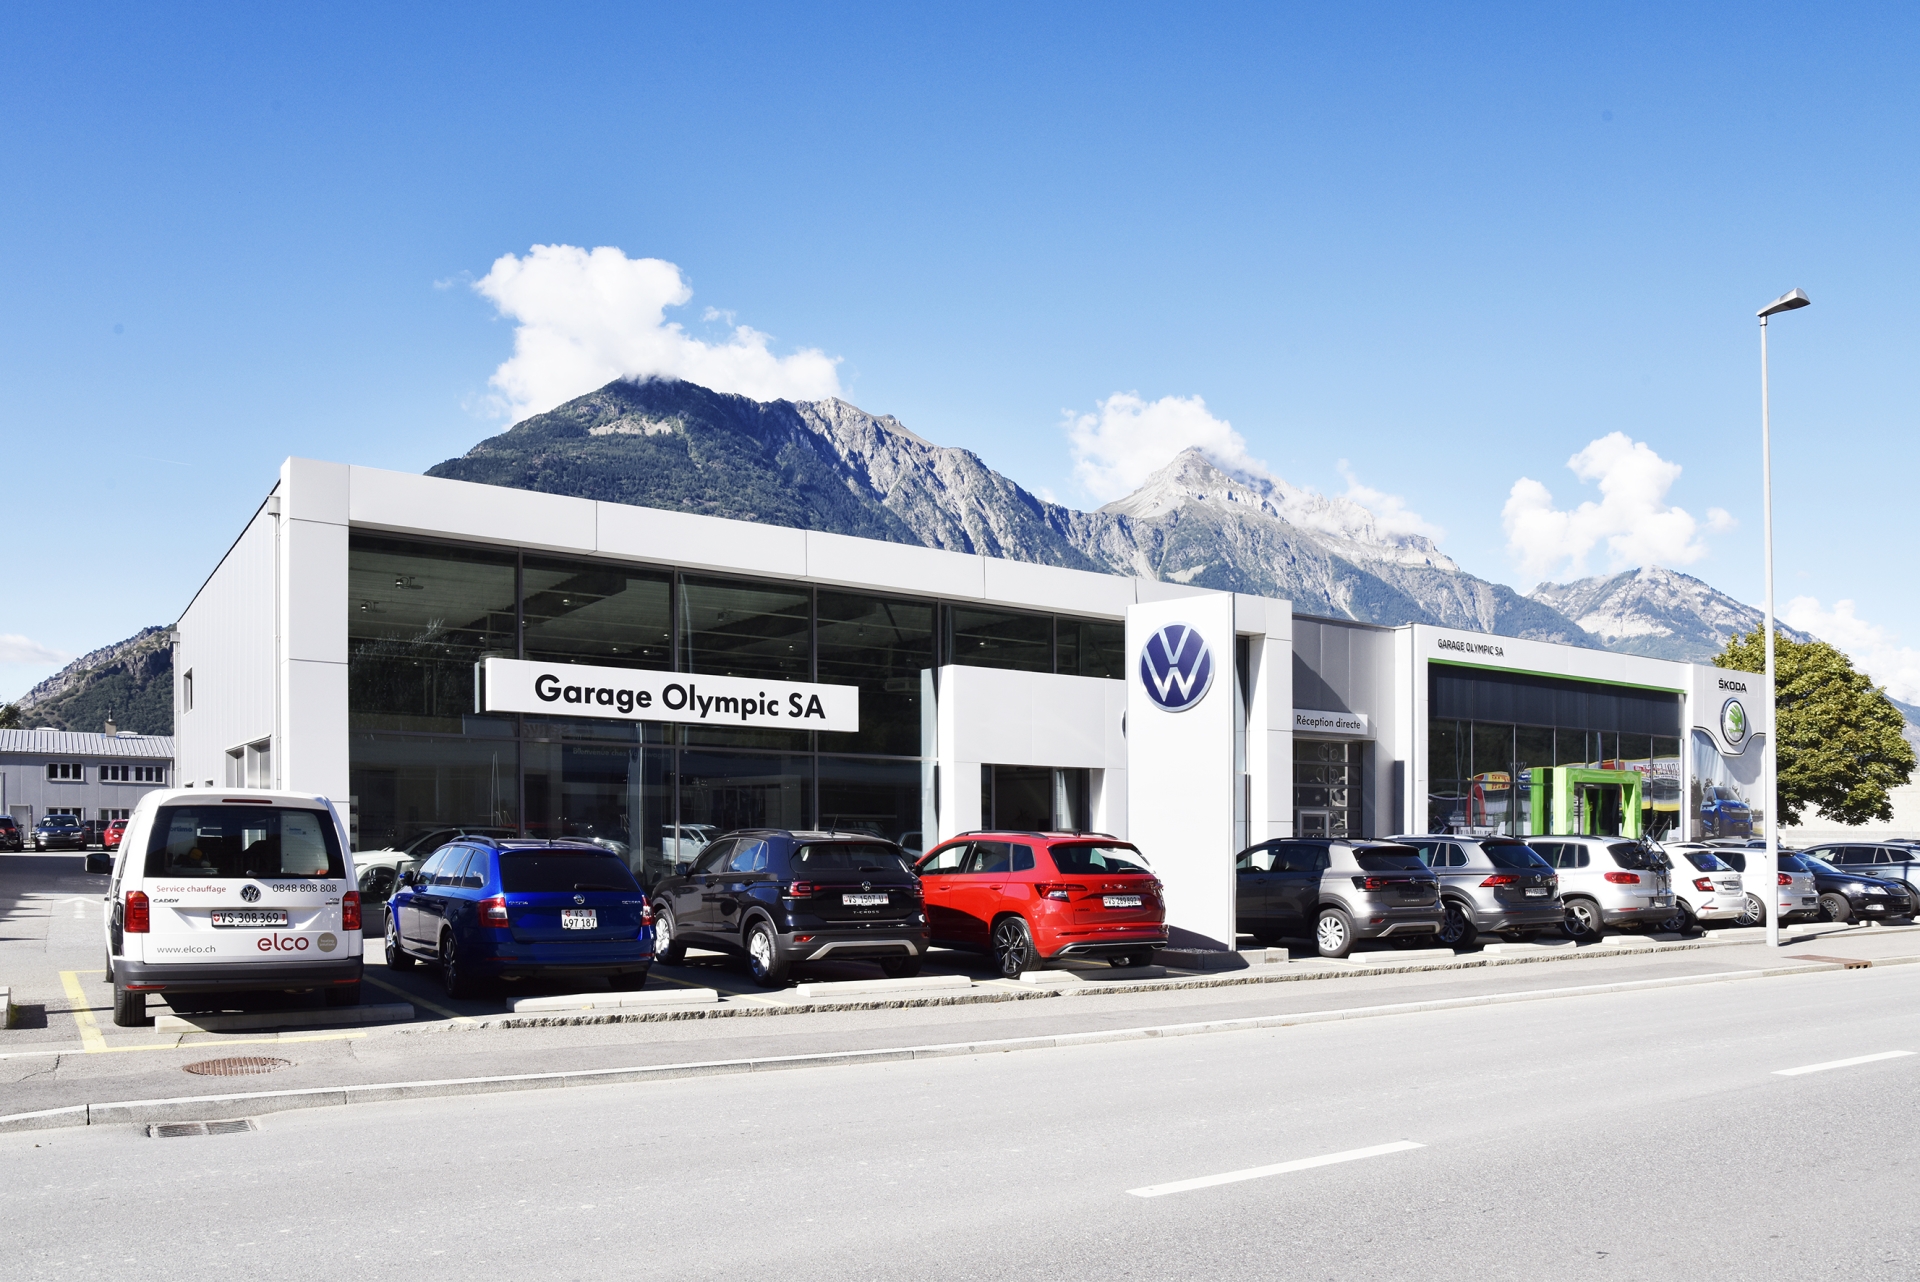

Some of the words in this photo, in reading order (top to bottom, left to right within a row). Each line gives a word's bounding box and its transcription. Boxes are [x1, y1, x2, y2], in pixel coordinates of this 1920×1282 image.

[1438, 639, 1465, 651] GARAGE
[1466, 643, 1494, 655] OLYMPIC
[1495, 647, 1504, 656] SA
[1718, 678, 1747, 692] ŠKODA
[534, 674, 652, 714] Garage
[662, 683, 780, 721] Olympic
[788, 693, 826, 720] SA
[1296, 714, 1334, 728] Réception
[1336, 717, 1361, 729] directe
[611, 749, 627, 757] chez
[156, 885, 185, 893] Service
[187, 885, 227, 894] chauffage
[272, 884, 298, 893] 0848
[300, 884, 318, 893] 808
[320, 884, 337, 893] 808
[563, 918, 579, 928] 497
[581, 918, 596, 928] 187
[257, 932, 310, 952] elco
[156, 945, 216, 953] www.elco.ch
